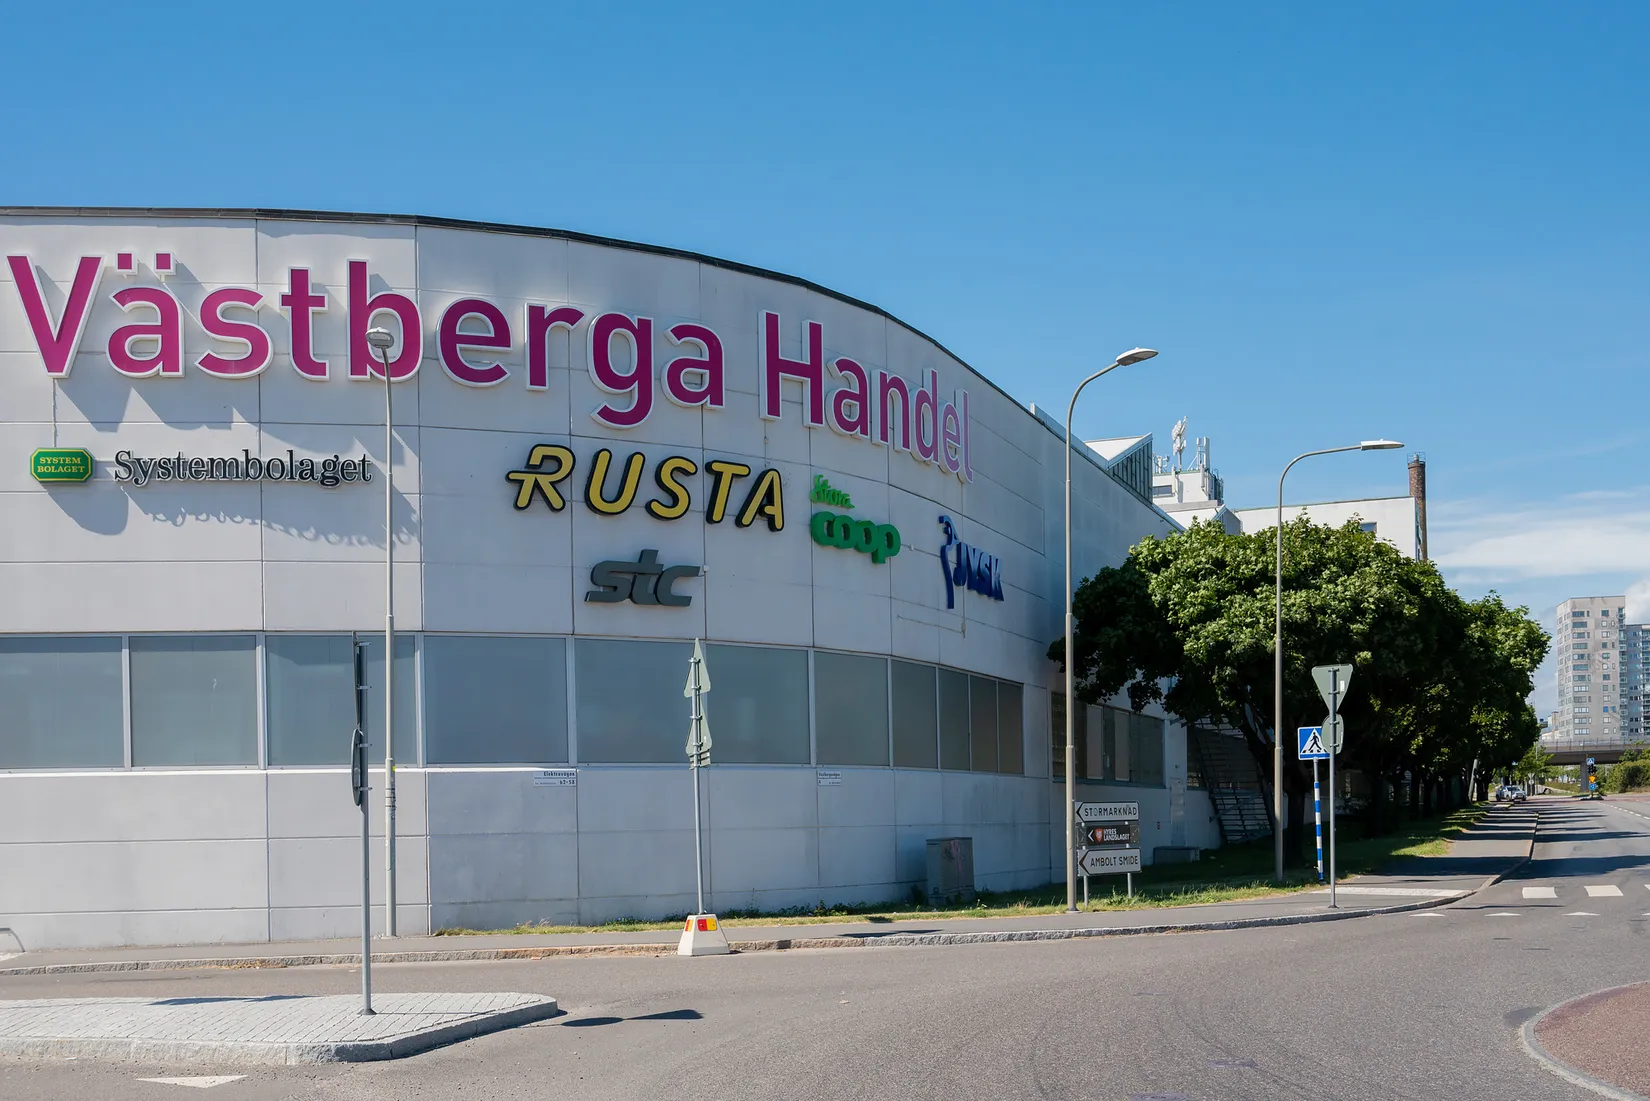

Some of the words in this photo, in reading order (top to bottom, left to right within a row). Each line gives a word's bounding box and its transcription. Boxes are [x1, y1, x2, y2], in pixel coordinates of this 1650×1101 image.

[6, 251, 725, 429] Västberga
[758, 310, 974, 484] Handel
[37, 465, 85, 473] BOLAGET
[39, 456, 82, 464] SYSTEM
[113, 448, 373, 488] Systembolaget
[505, 443, 785, 532] RUSTA
[810, 474, 855, 509] Stora
[810, 511, 901, 564] coop
[584, 548, 701, 607] stc
[953, 541, 1004, 602] JYSK
[1084, 807, 1137, 817] STORMARKNAD
[1090, 857, 1117, 867] AMBOLT
[1119, 855, 1138, 865] SMIDE
